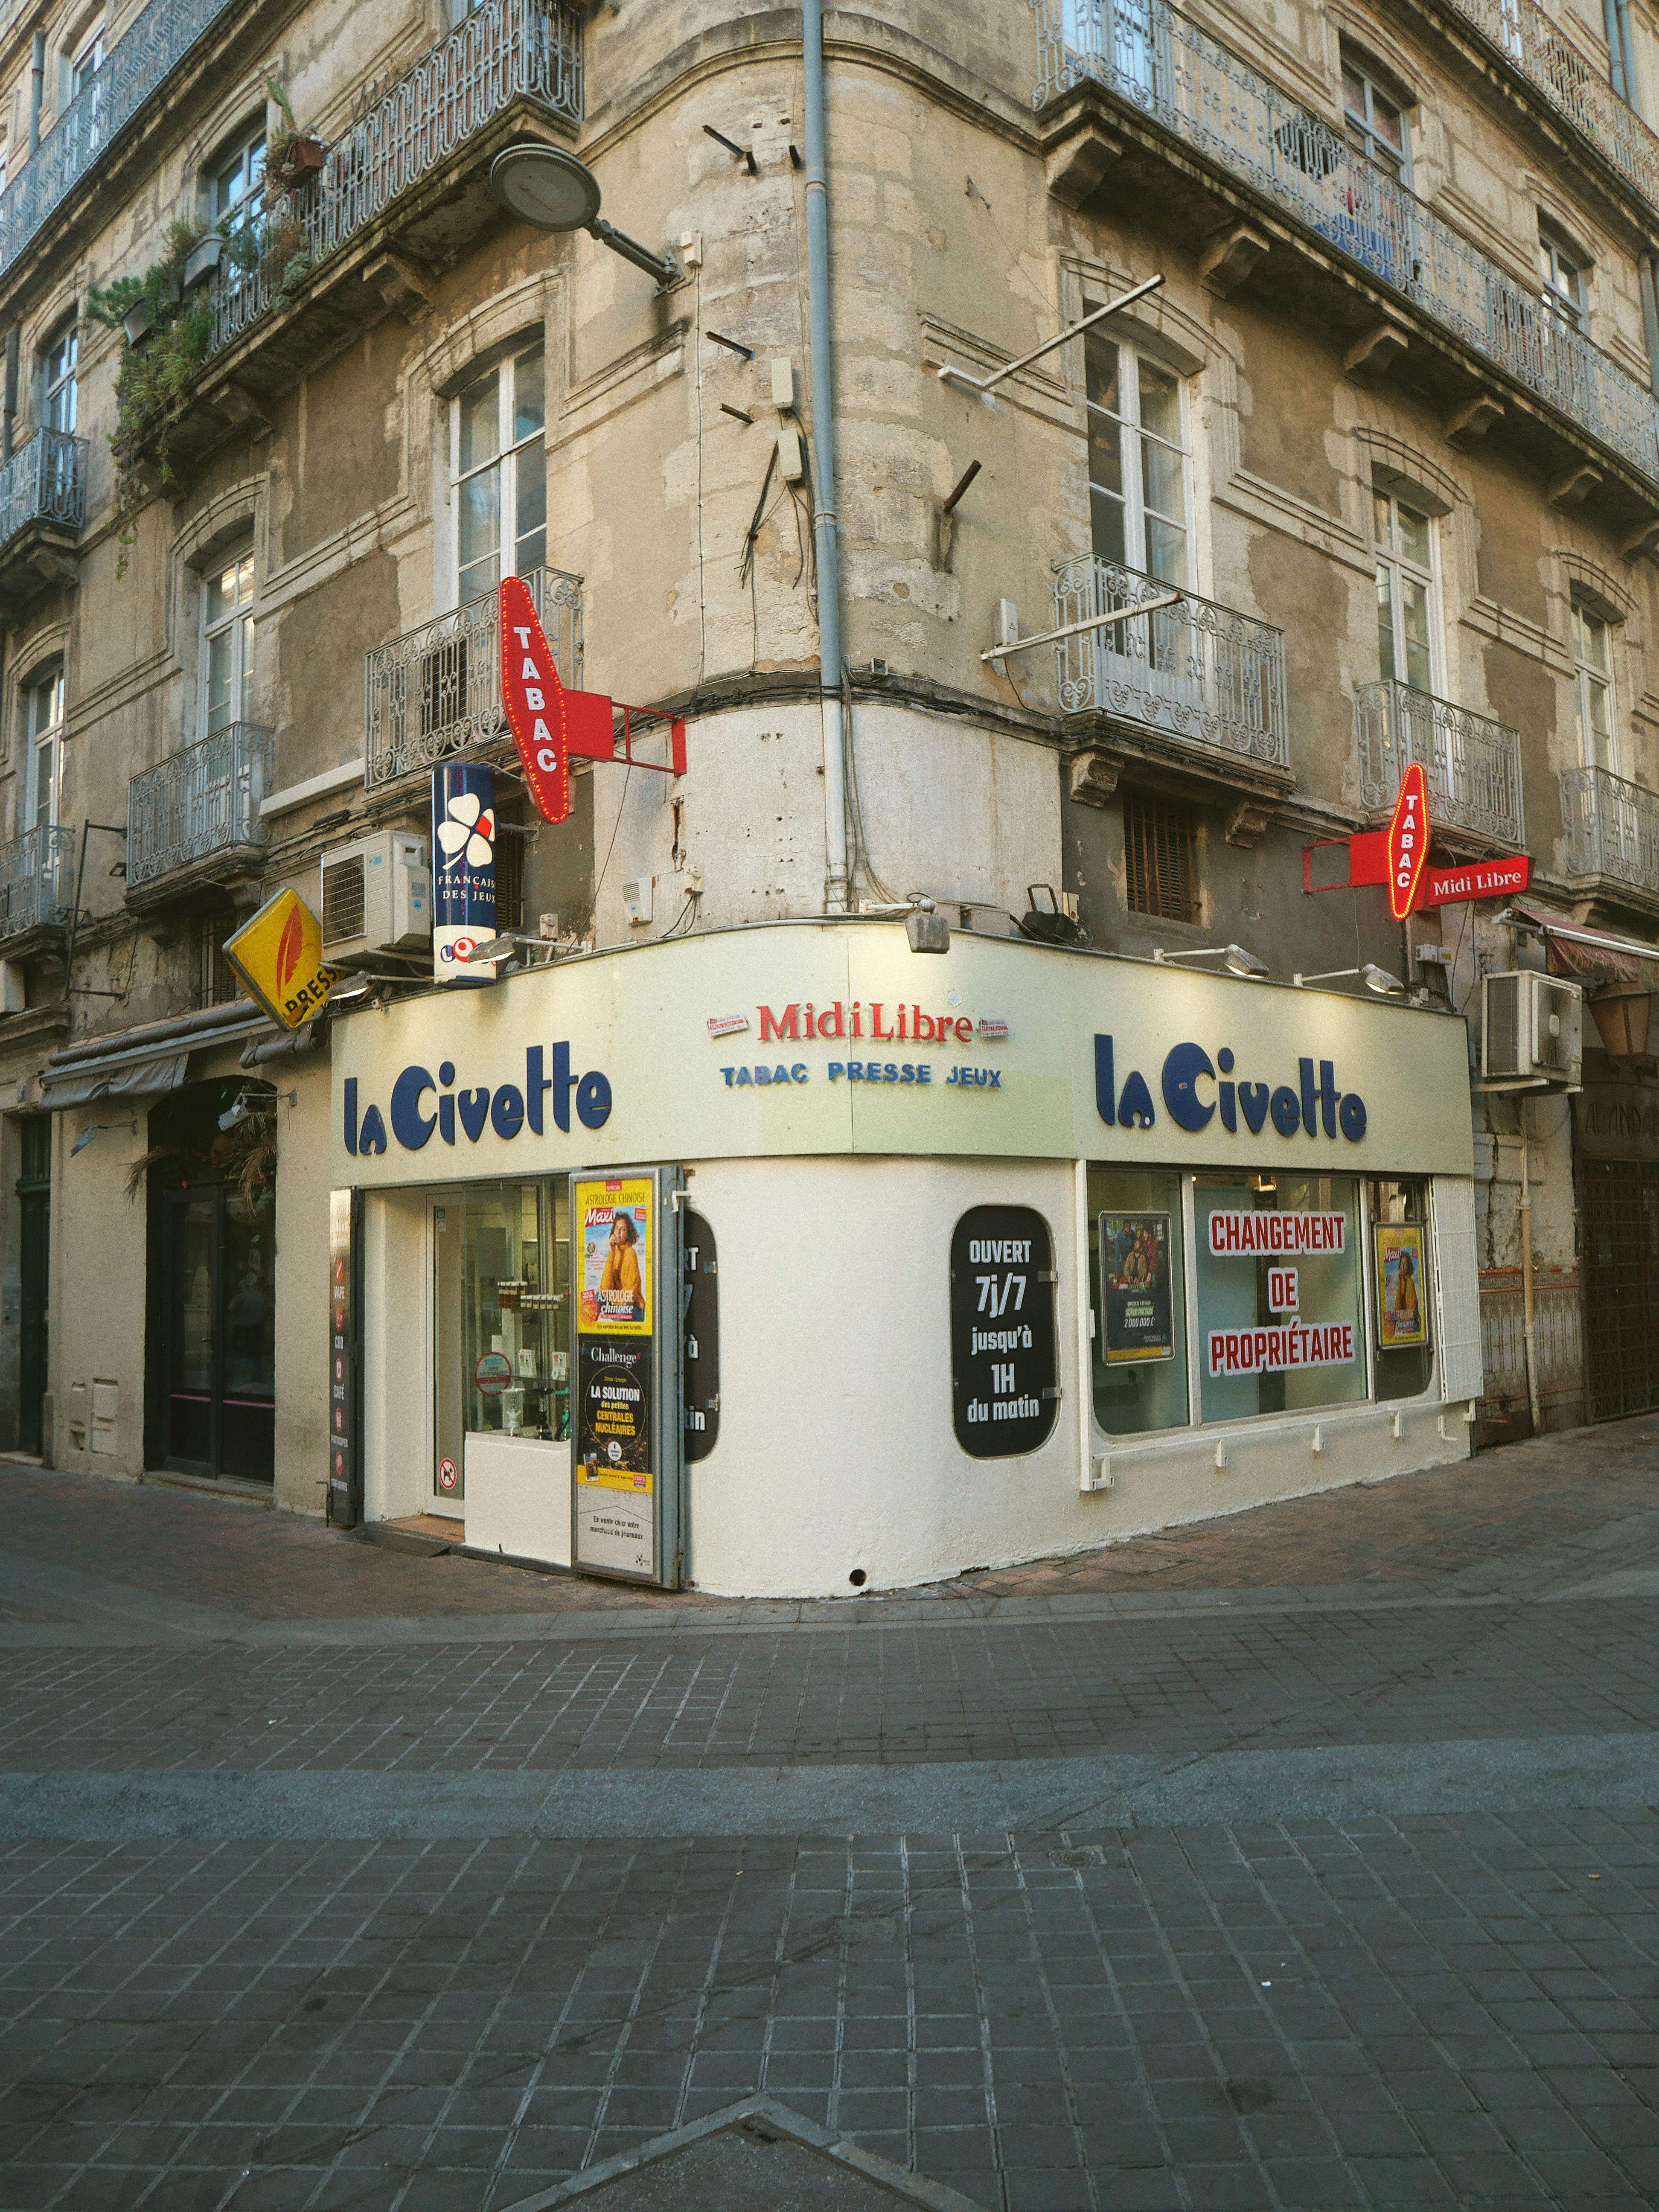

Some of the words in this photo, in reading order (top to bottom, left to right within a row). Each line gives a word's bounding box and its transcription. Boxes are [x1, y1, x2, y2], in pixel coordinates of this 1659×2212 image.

[513, 626, 557, 772] TABAC
[1397, 795, 1418, 888] TABAC
[1433, 876, 1472, 896] Midi
[1476, 871, 1522, 889] Libre
[442, 890, 466, 899] DES
[472, 891, 495, 903] JEUX
[721, 1063, 807, 1086] TABAC
[828, 1062, 931, 1083] PRESSE
[947, 1066, 1002, 1088] JEUX
[585, 1193, 616, 1205] ASTROLOGIE
[619, 1192, 646, 1204] CHINOISE
[585, 1208, 614, 1225] Maxi
[1212, 1215, 1345, 1252] CHANGEMENT
[969, 1240, 1032, 1263] OUVERT
[334, 1286, 345, 1300] VAPE
[598, 1289, 634, 1302] ASTROLOGIE
[975, 1272, 1027, 1318] 7j/7
[1272, 1272, 1297, 1307] DE
[601, 1301, 634, 1314] chinoise
[1124, 1318, 1128, 1328] 2
[1129, 1318, 1139, 1327] 000
[1140, 1317, 1150, 1327] 000
[1212, 1321, 1353, 1372] PROPRIÉTAIRE
[591, 1347, 641, 1368] Challenges
[991, 1363, 1015, 1394] 1H
[591, 1385, 601, 1398] LA
[602, 1386, 640, 1402] SOLUTION
[601, 1400, 611, 1408] des
[611, 1401, 629, 1410] petites
[967, 1398, 989, 1423] du
[993, 1394, 1039, 1420] matin
[597, 1410, 634, 1423] CENTRALES
[595, 1421, 636, 1436] NUCLÉAIRES
[615, 1519, 626, 1527] chez
[591, 1526, 614, 1535] marchand
[621, 1530, 643, 1540] journaux
